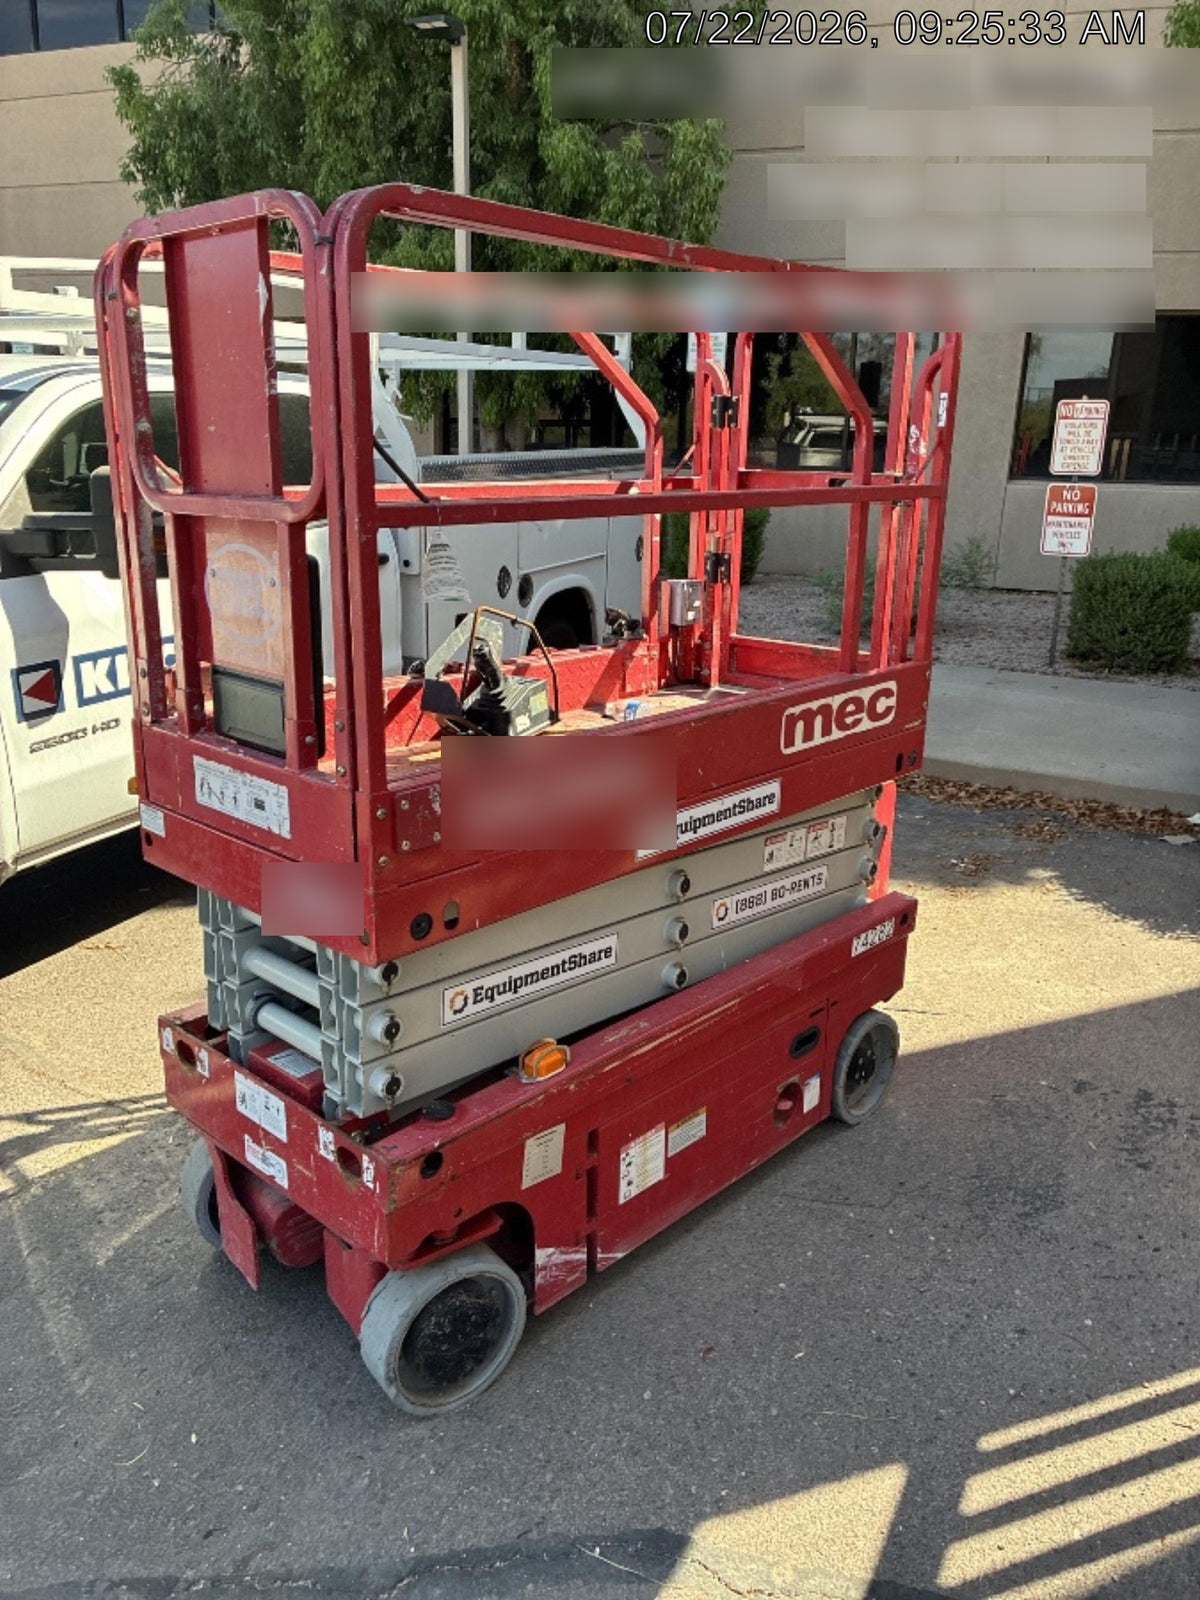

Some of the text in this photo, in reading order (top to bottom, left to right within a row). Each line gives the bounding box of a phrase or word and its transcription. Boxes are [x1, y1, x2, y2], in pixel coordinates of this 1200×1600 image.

[1060, 404, 1073, 417] NO
[1062, 489, 1080, 501] NO
[1050, 501, 1089, 514] PARKING
[783, 687, 896, 750] mec
[471, 945, 613, 1005] EquipmentShare
